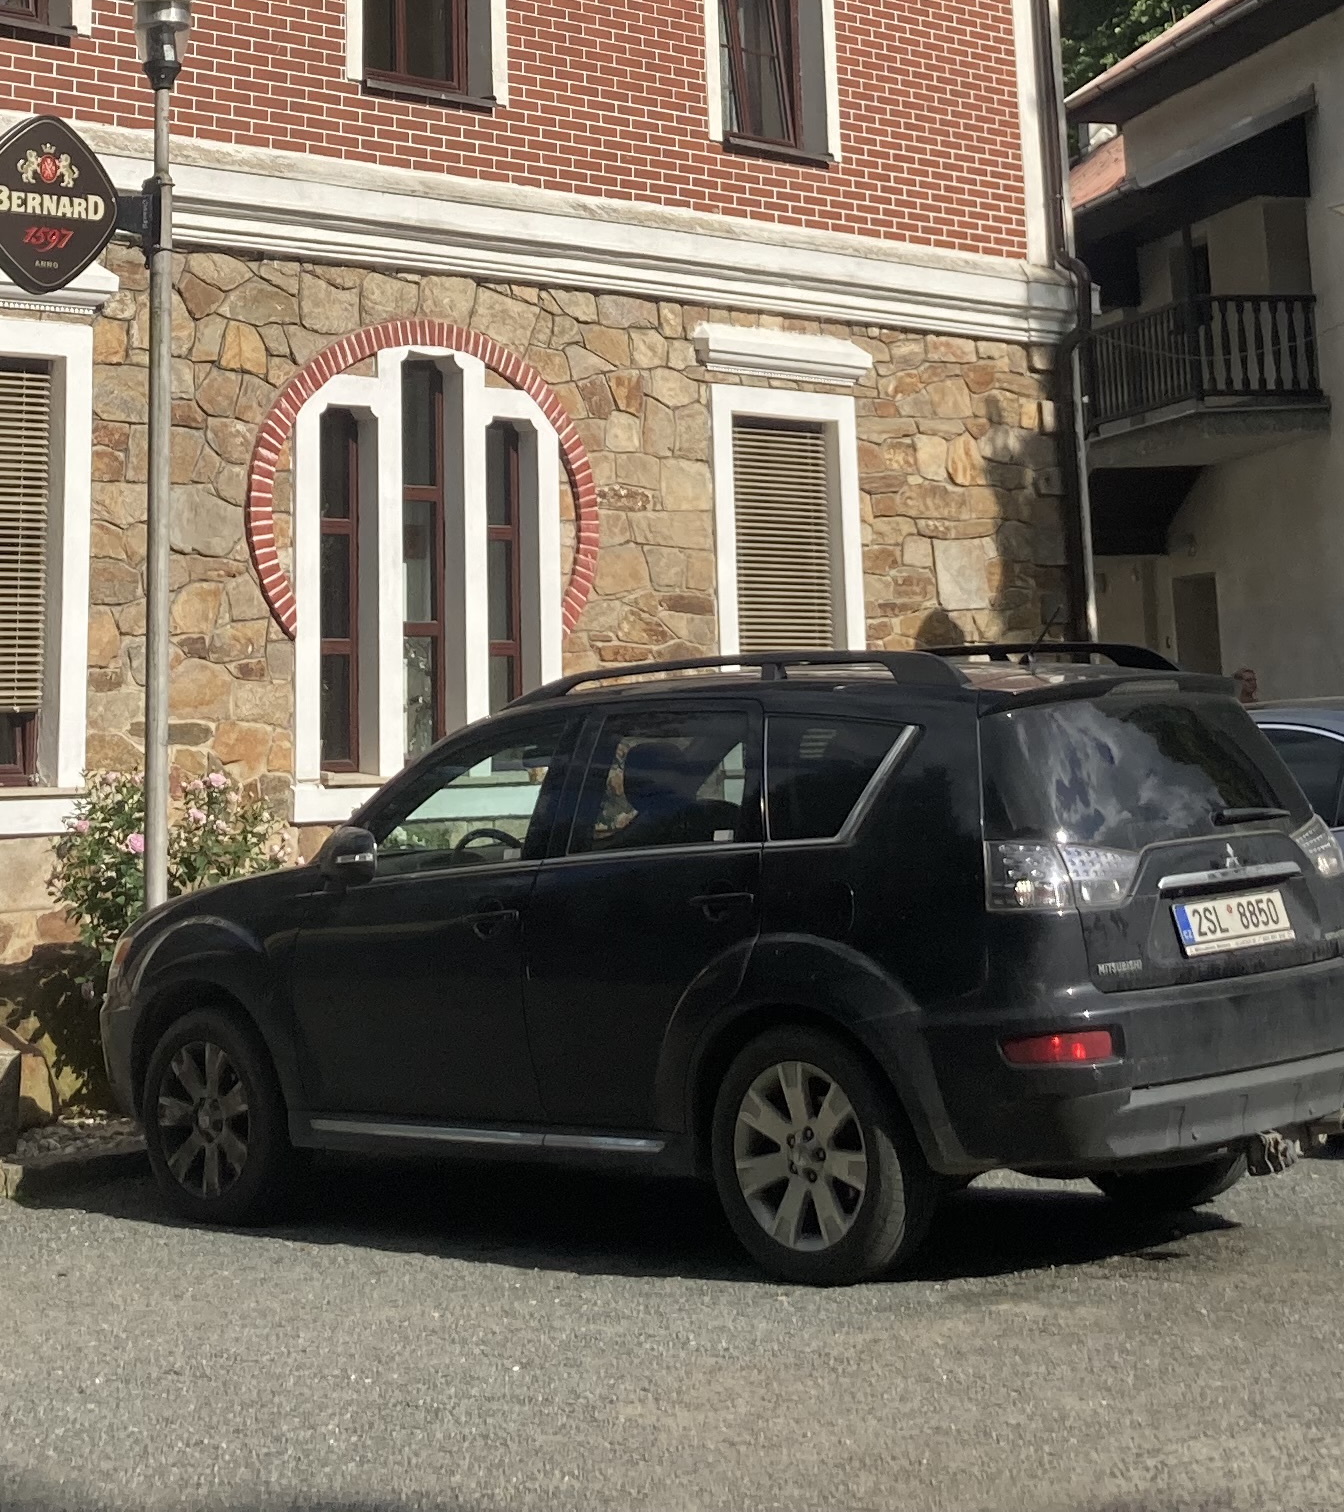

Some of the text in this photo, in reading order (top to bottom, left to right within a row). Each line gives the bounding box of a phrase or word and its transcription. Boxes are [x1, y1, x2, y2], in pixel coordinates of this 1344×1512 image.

[22, 226, 75, 253] 1597
[34, 259, 59, 269] ANNO
[1191, 897, 1280, 937] 2SL 8850
